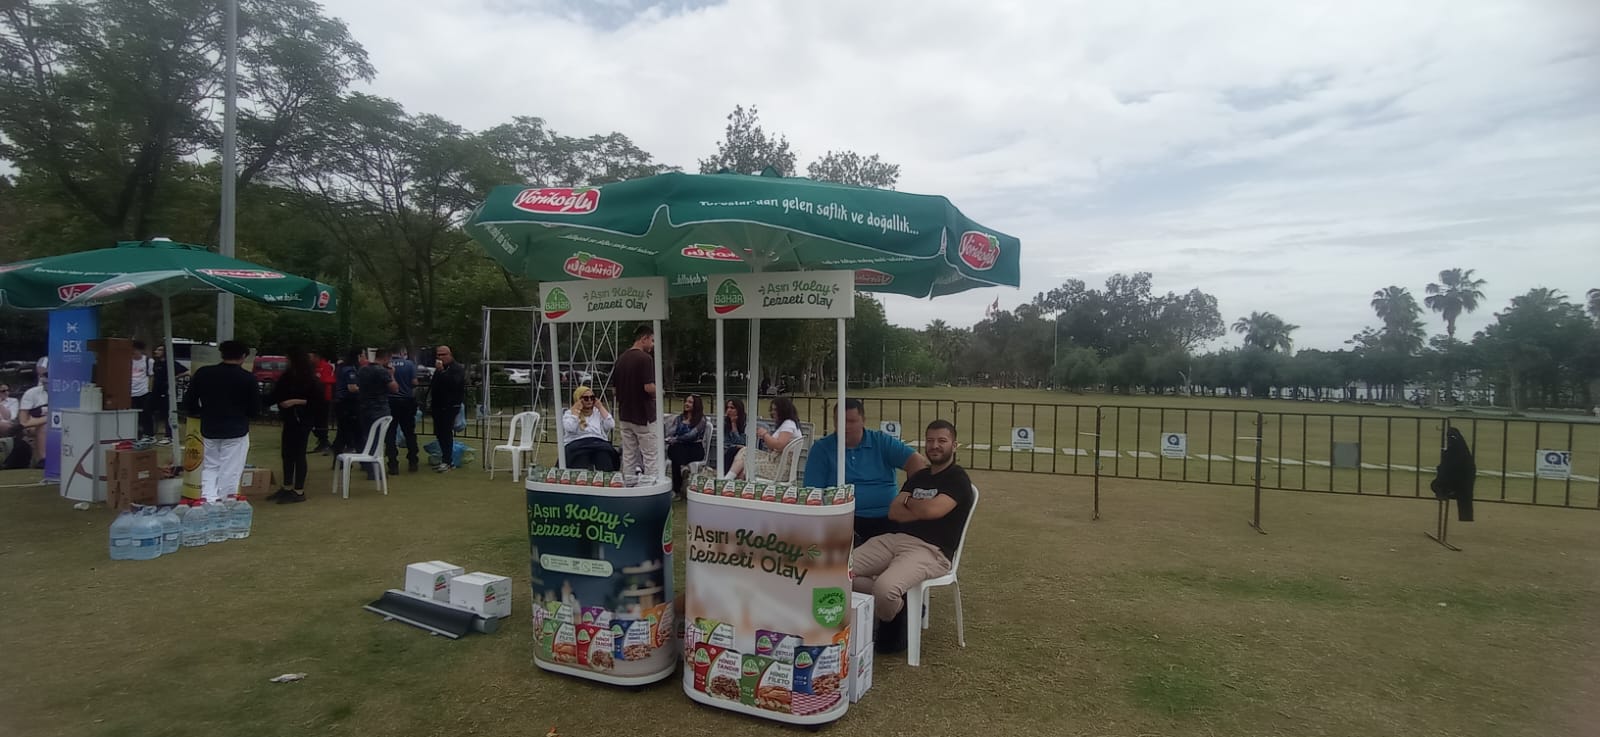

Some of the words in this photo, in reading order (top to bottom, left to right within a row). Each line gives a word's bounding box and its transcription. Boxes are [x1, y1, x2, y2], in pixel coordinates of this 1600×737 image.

[782, 197, 813, 214] gelen
[816, 203, 848, 221] saflık
[851, 211, 864, 225] ve
[611, 287, 646, 300] Kolay
[792, 280, 832, 295] Kolay
[587, 300, 623, 312] Lezzeti
[625, 299, 648, 312] Olay
[762, 294, 804, 308] Lezzeti
[807, 294, 833, 309] Olay
[62, 340, 82, 353] BEX
[565, 504, 621, 529] Kolay
[531, 521, 583, 539] Lezzeti
[586, 525, 625, 549] Olay
[735, 529, 804, 561] Kolay
[689, 545, 755, 569] Lezzeti
[761, 555, 809, 585] Olay
